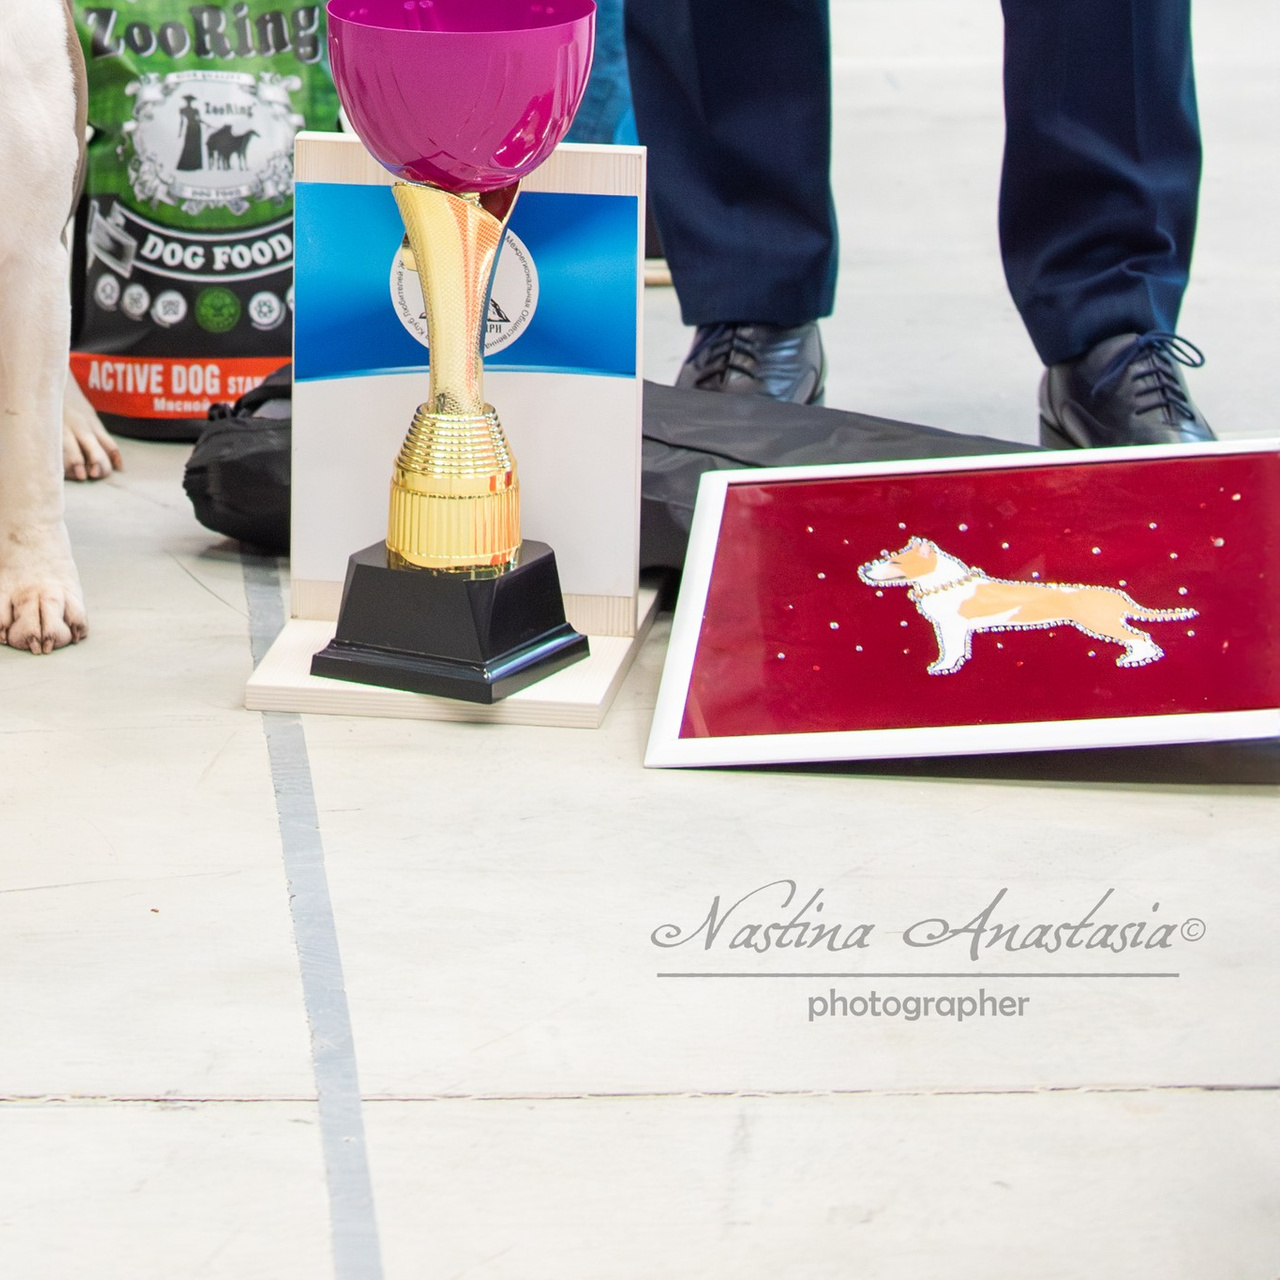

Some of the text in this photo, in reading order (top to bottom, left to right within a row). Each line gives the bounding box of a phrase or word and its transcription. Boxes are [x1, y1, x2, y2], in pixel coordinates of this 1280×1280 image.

[84, 1, 324, 65] ZooRing
[140, 233, 294, 271] DOG FOOD
[484, 309, 530, 350] Общественна
[88, 361, 164, 394] ACTIVE
[171, 363, 220, 395] DOG
